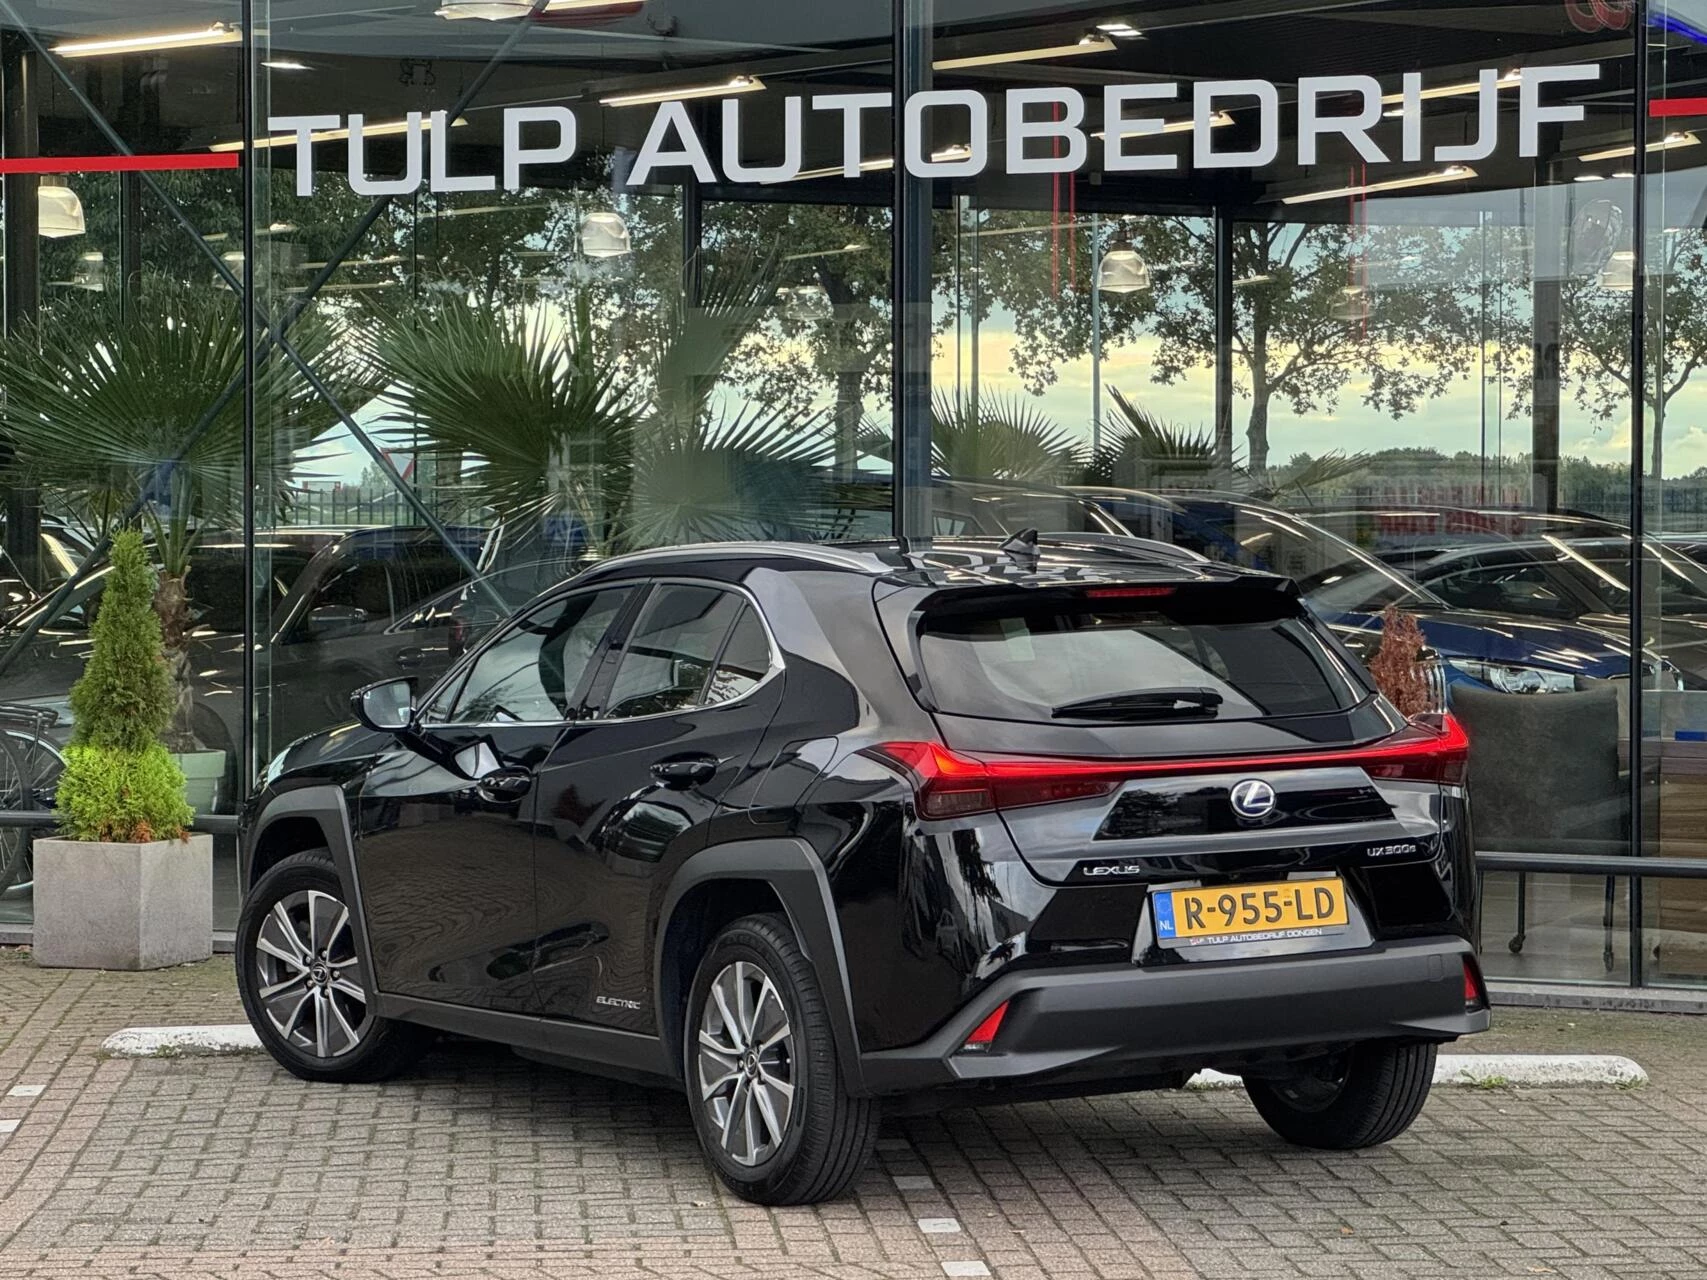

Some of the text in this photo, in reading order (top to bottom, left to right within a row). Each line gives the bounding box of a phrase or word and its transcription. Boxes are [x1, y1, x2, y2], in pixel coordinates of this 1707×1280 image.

[268, 63, 1602, 197] TULP AUTOBEDRIJF
[1083, 865, 1140, 876] LEXUS
[1159, 887, 1335, 931] NL R-955-LD
[1207, 936, 1229, 944] TULP
[1230, 931, 1286, 942] AUTOBEDRIJF
[1286, 928, 1322, 937] DONGEN
[596, 996, 641, 1009] ELECTRIC
